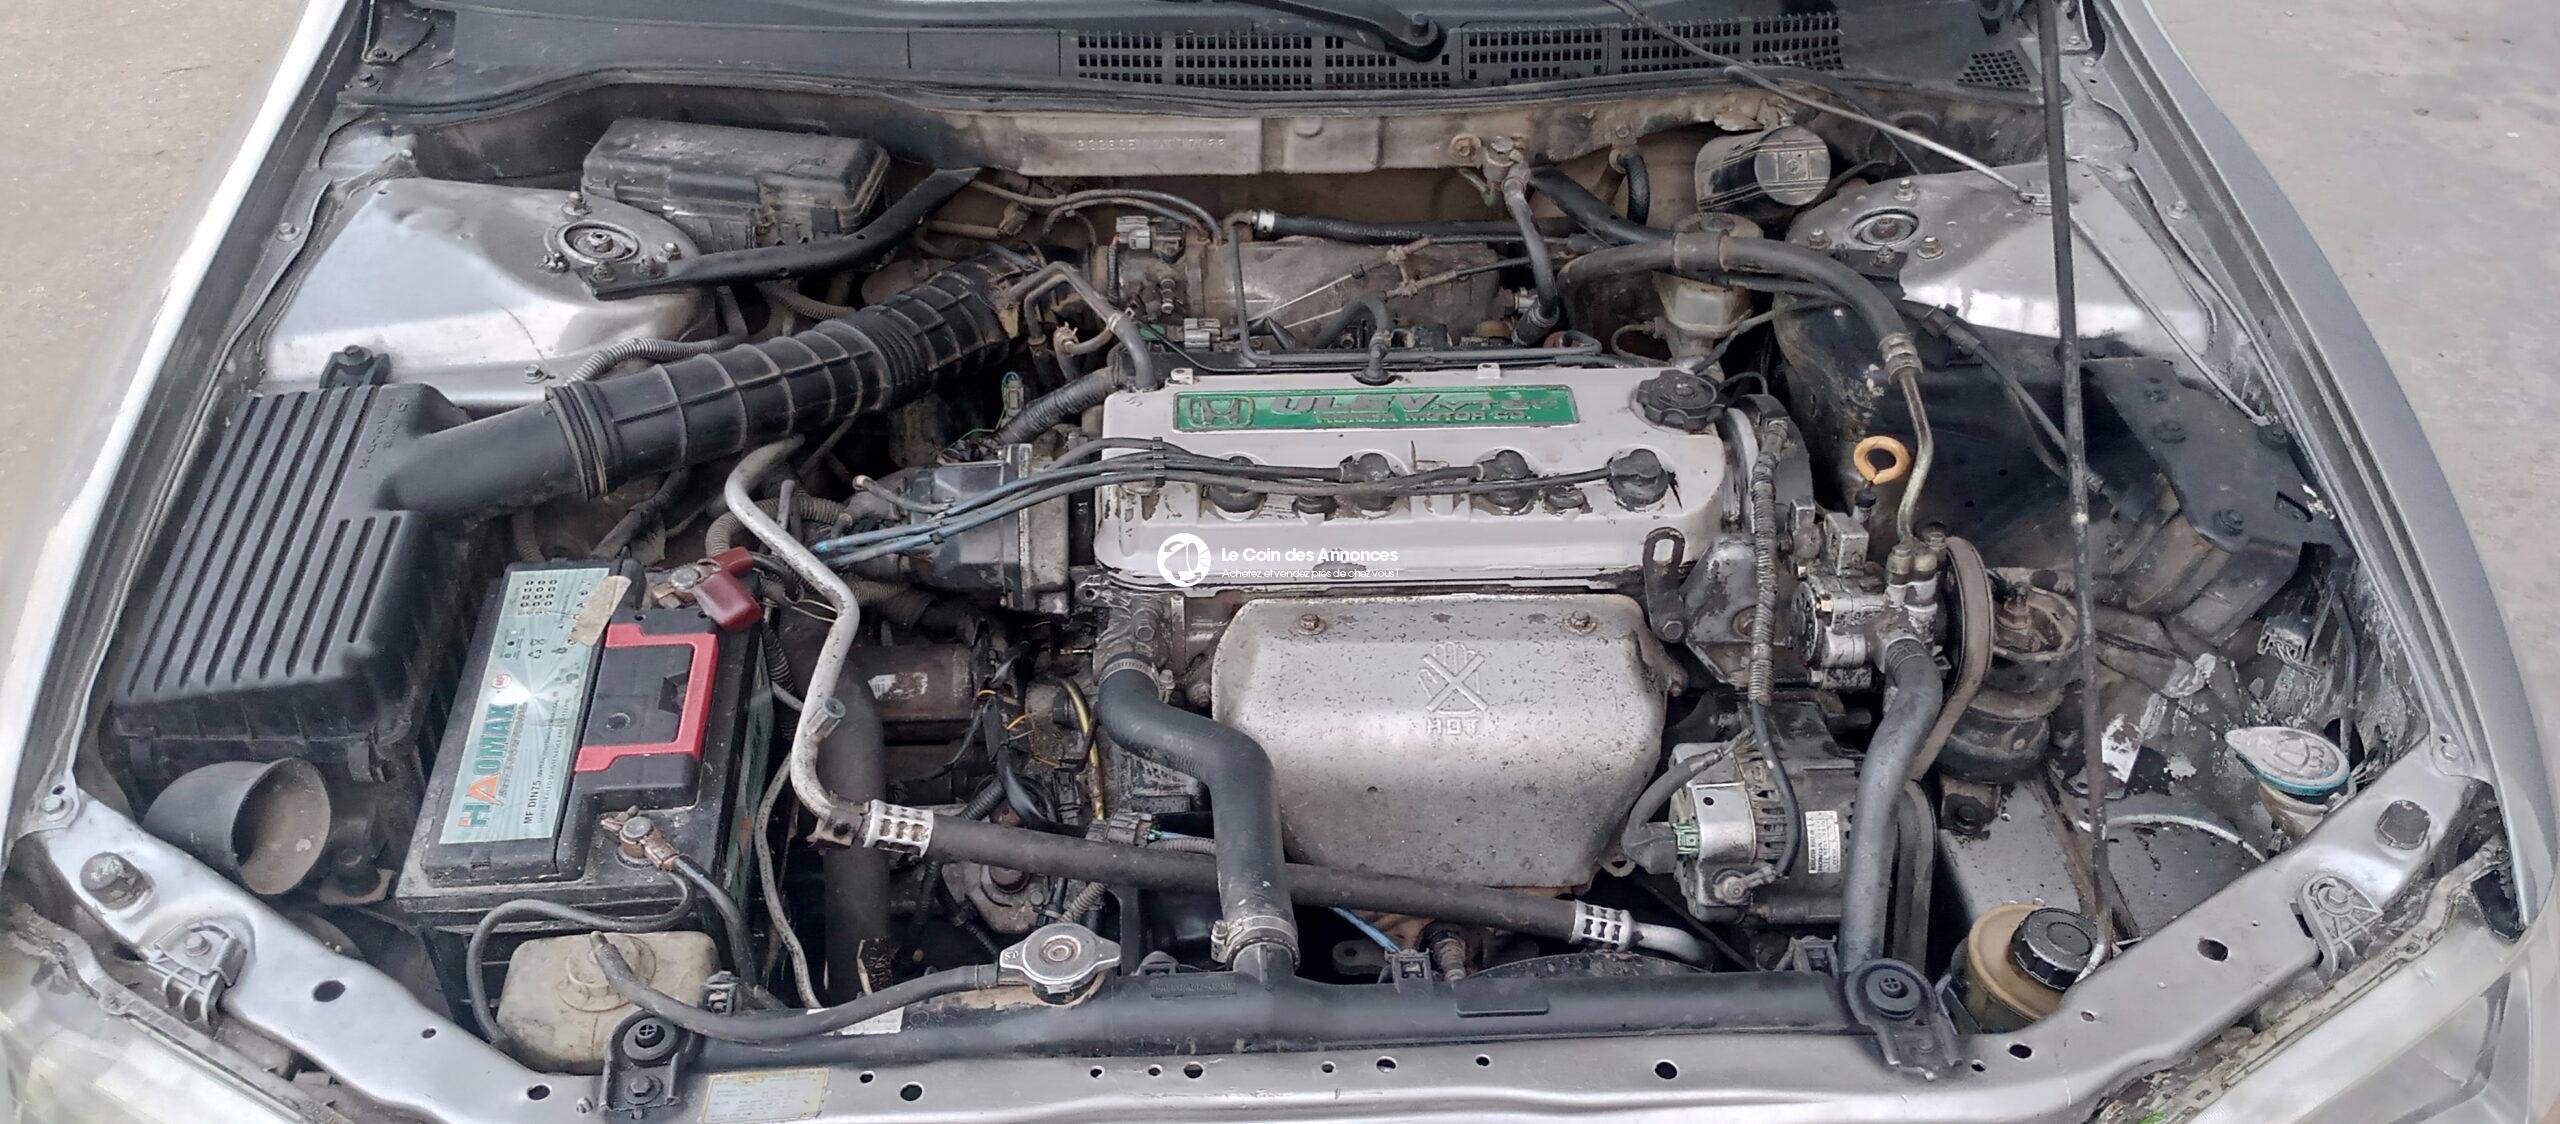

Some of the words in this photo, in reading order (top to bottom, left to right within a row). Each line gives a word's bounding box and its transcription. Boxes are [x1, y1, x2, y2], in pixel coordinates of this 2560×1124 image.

[1405, 411, 1487, 421] MOTOR
[1426, 716, 1480, 734] HOT
[456, 702, 517, 828] HAOMAX
[526, 780, 543, 808] DIN75
[522, 810, 536, 825] MF
